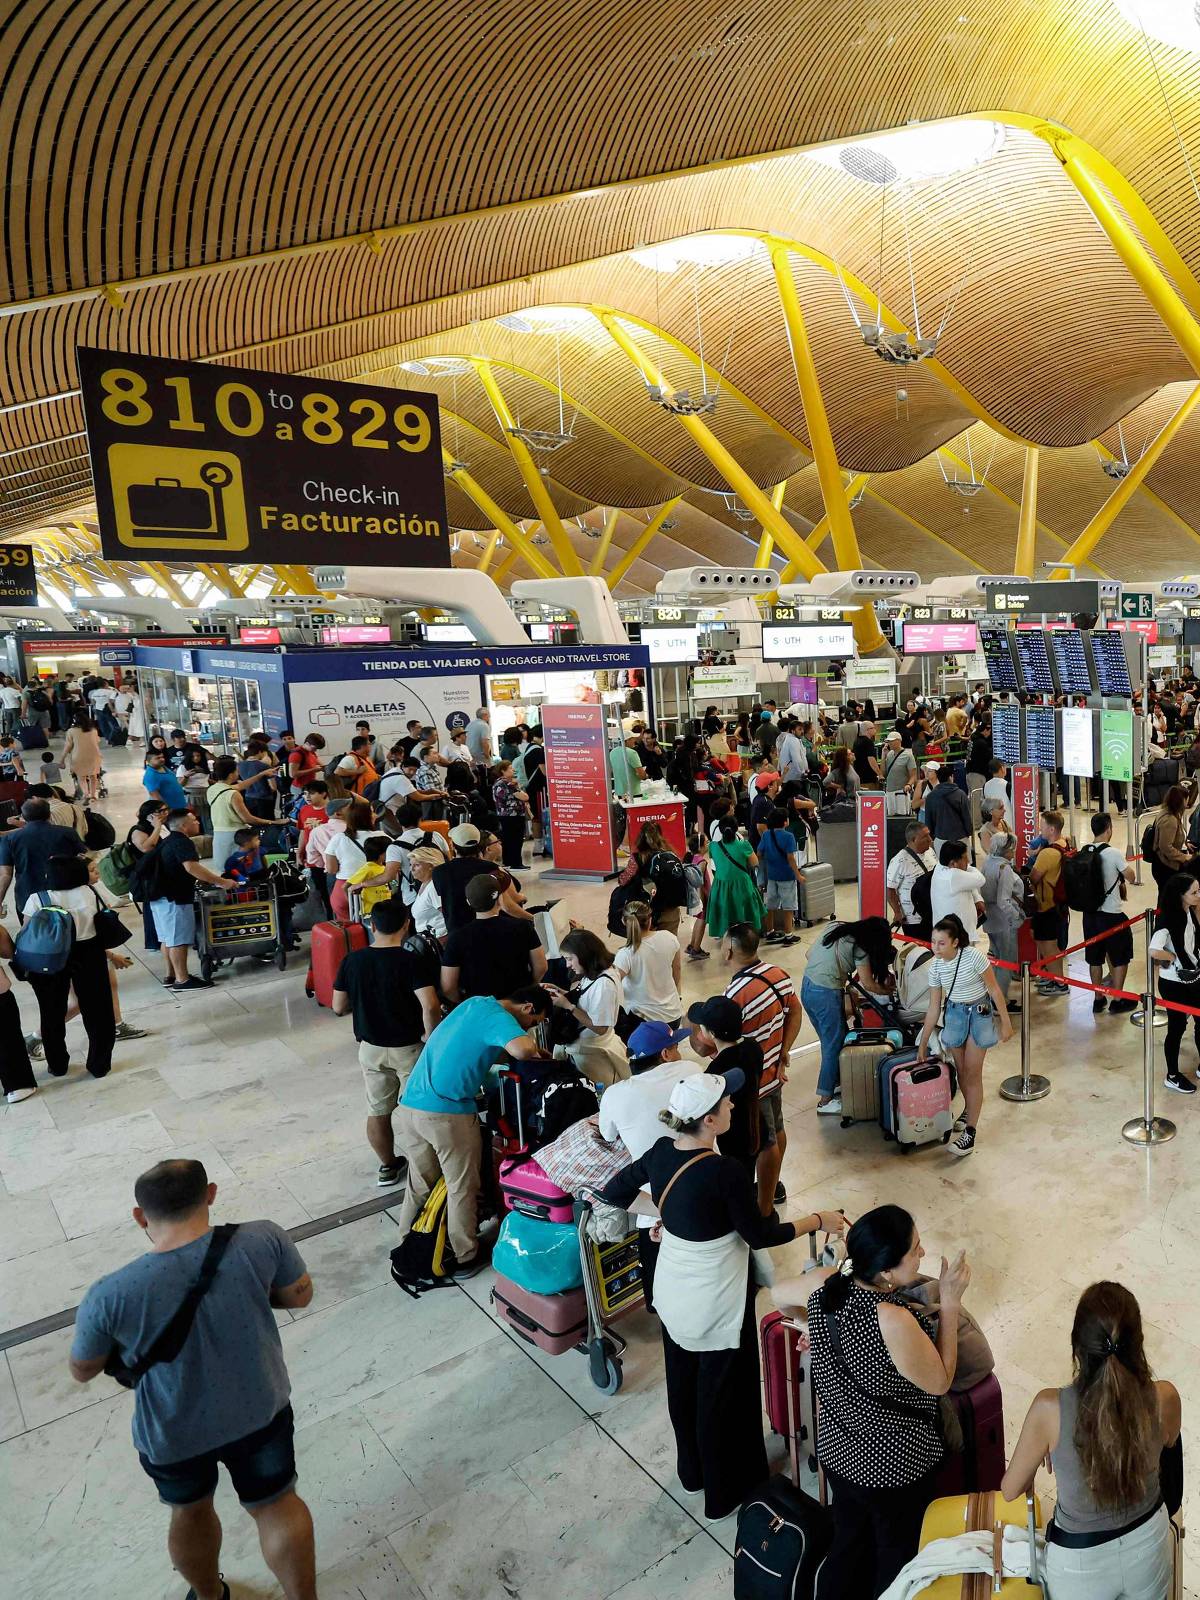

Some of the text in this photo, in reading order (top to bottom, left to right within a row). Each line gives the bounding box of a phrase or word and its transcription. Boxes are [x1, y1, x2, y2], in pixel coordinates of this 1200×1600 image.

[101, 368, 433, 453] 810 to 829
[275, 420, 294, 441] a
[303, 480, 401, 507] Check-in
[260, 505, 441, 537] Facturación
[657, 608, 682, 621] 820
[775, 608, 795, 619] 821
[821, 608, 841, 619] 822
[914, 608, 931, 619] 823
[950, 608, 967, 619] 824
[363, 653, 631, 671] TIENDA DEL VIAJERO LUGGAGE AND TRAVEL STORE
[344, 702, 406, 714] MALETAS
[1021, 790, 1035, 826] sales
[636, 814, 666, 823] IBERIA
